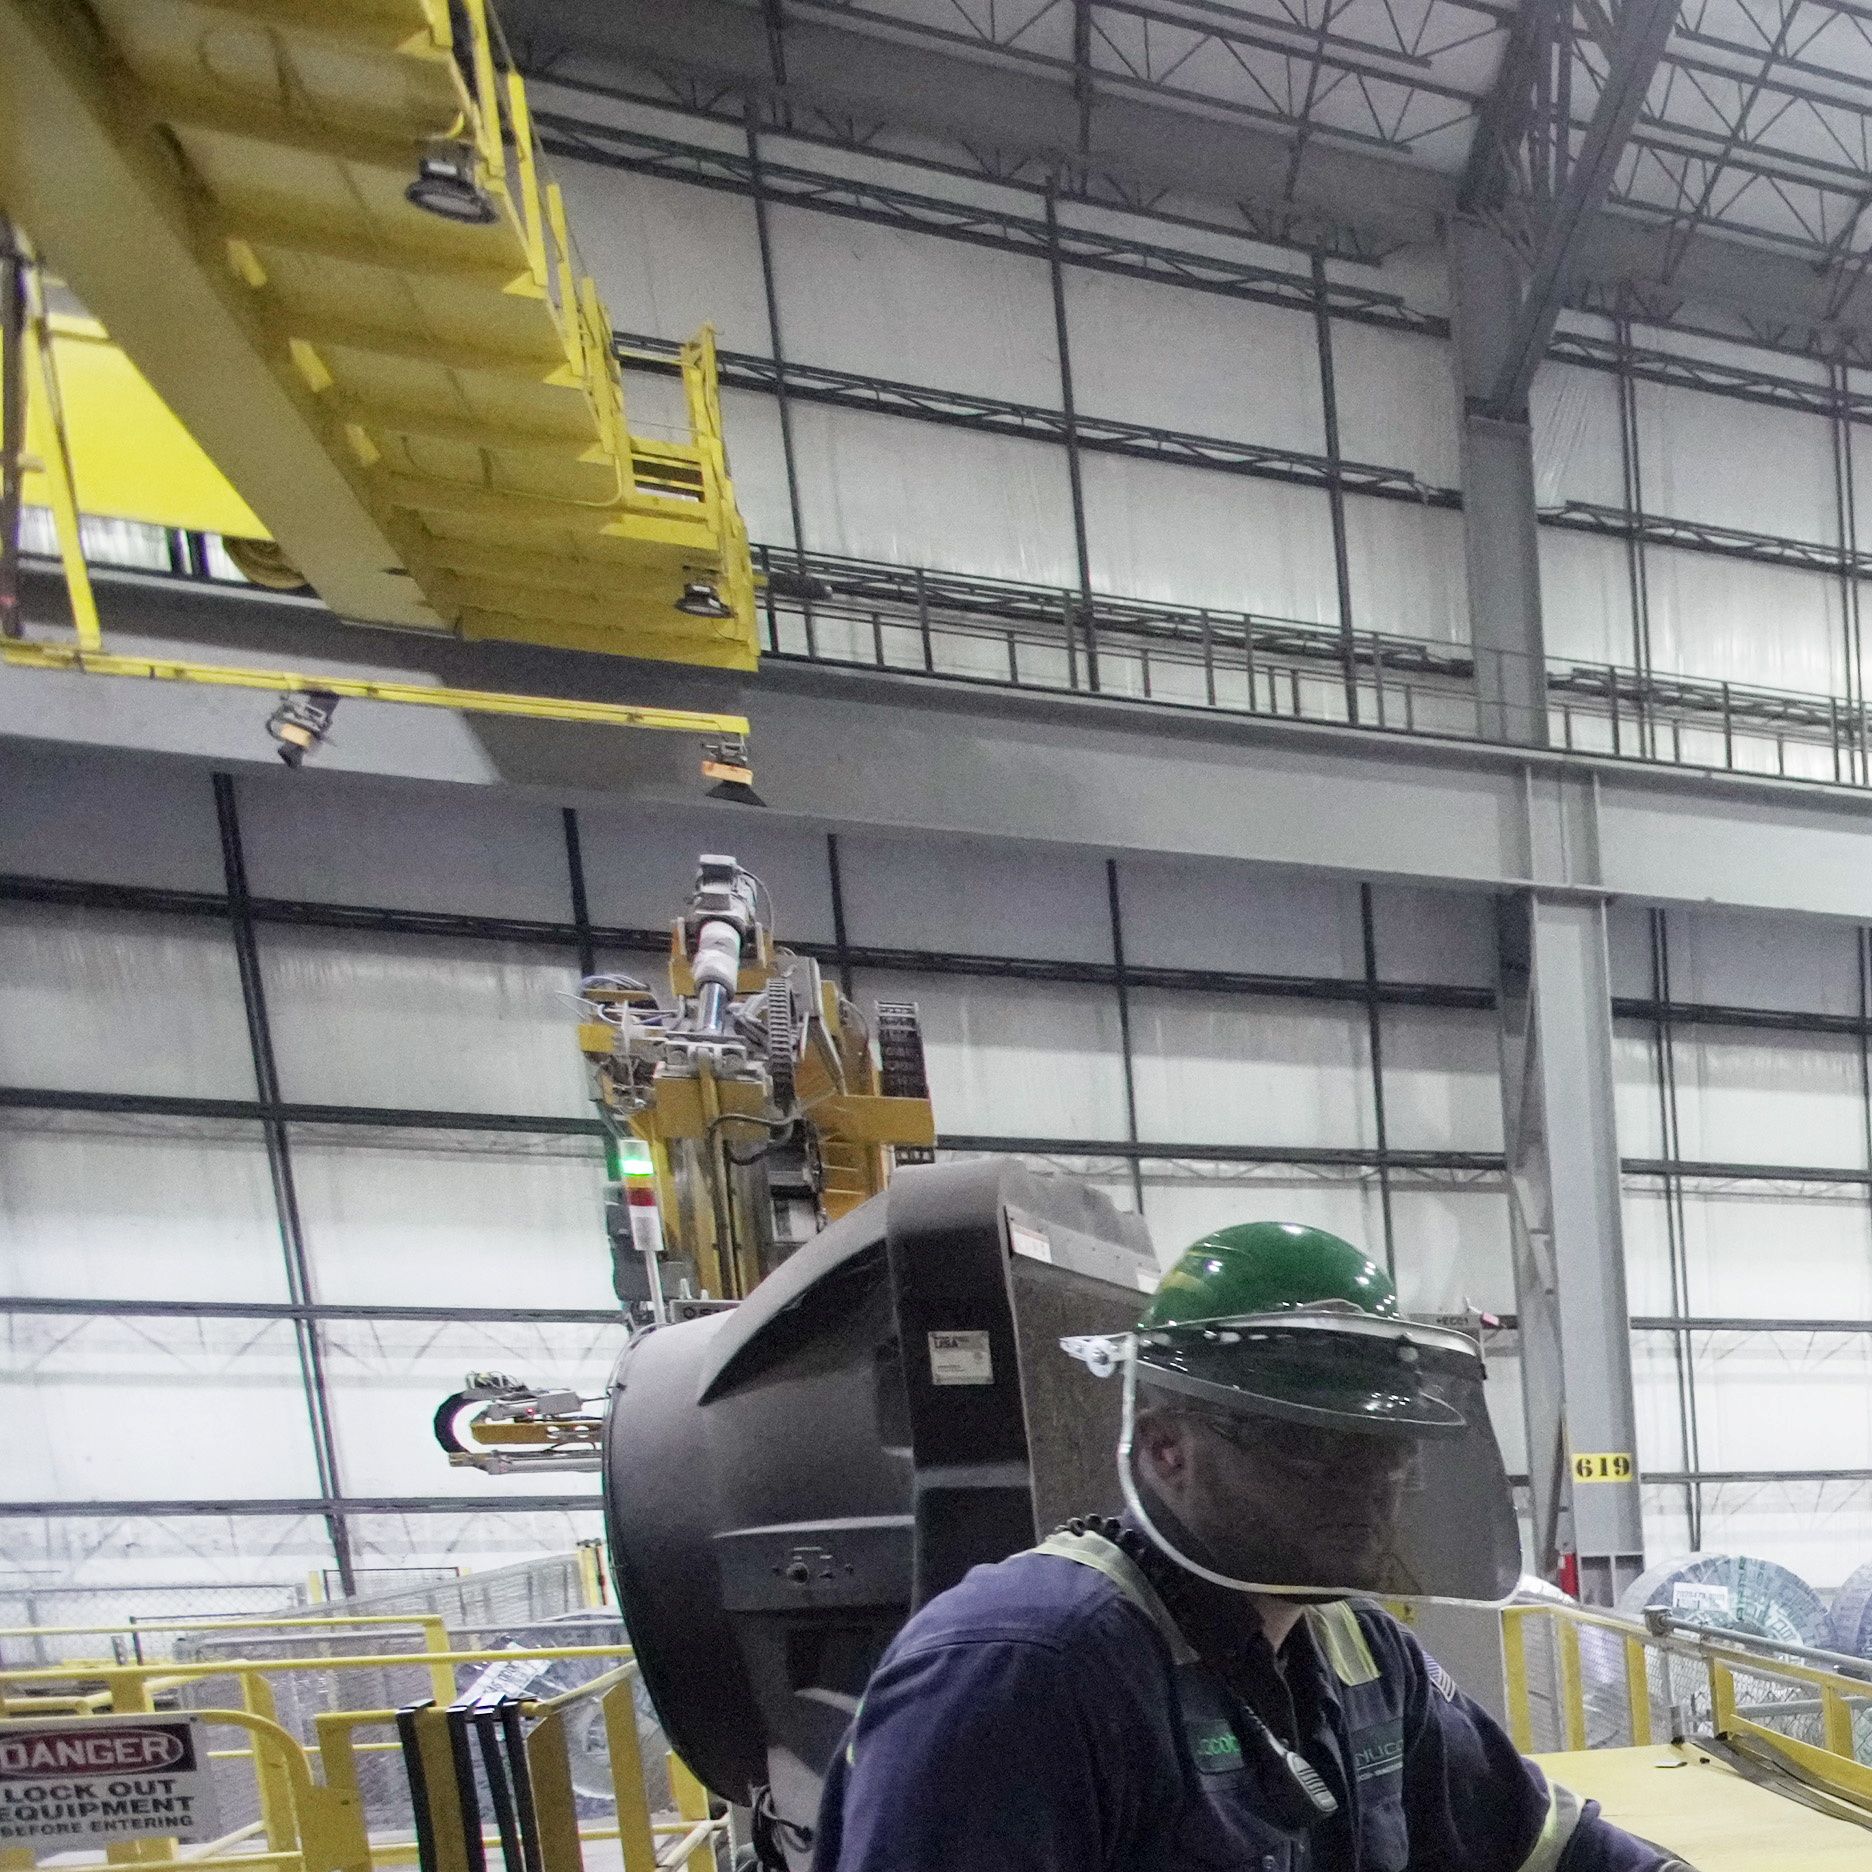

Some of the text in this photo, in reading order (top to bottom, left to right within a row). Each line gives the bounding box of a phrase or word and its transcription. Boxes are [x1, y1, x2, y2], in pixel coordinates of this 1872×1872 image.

[1576, 1456, 1630, 1478] 619
[0, 1737, 172, 1770] DANGER
[4, 1779, 176, 1804] LOCK OUT
[1, 1815, 193, 1838] BEFORE ENTERING
